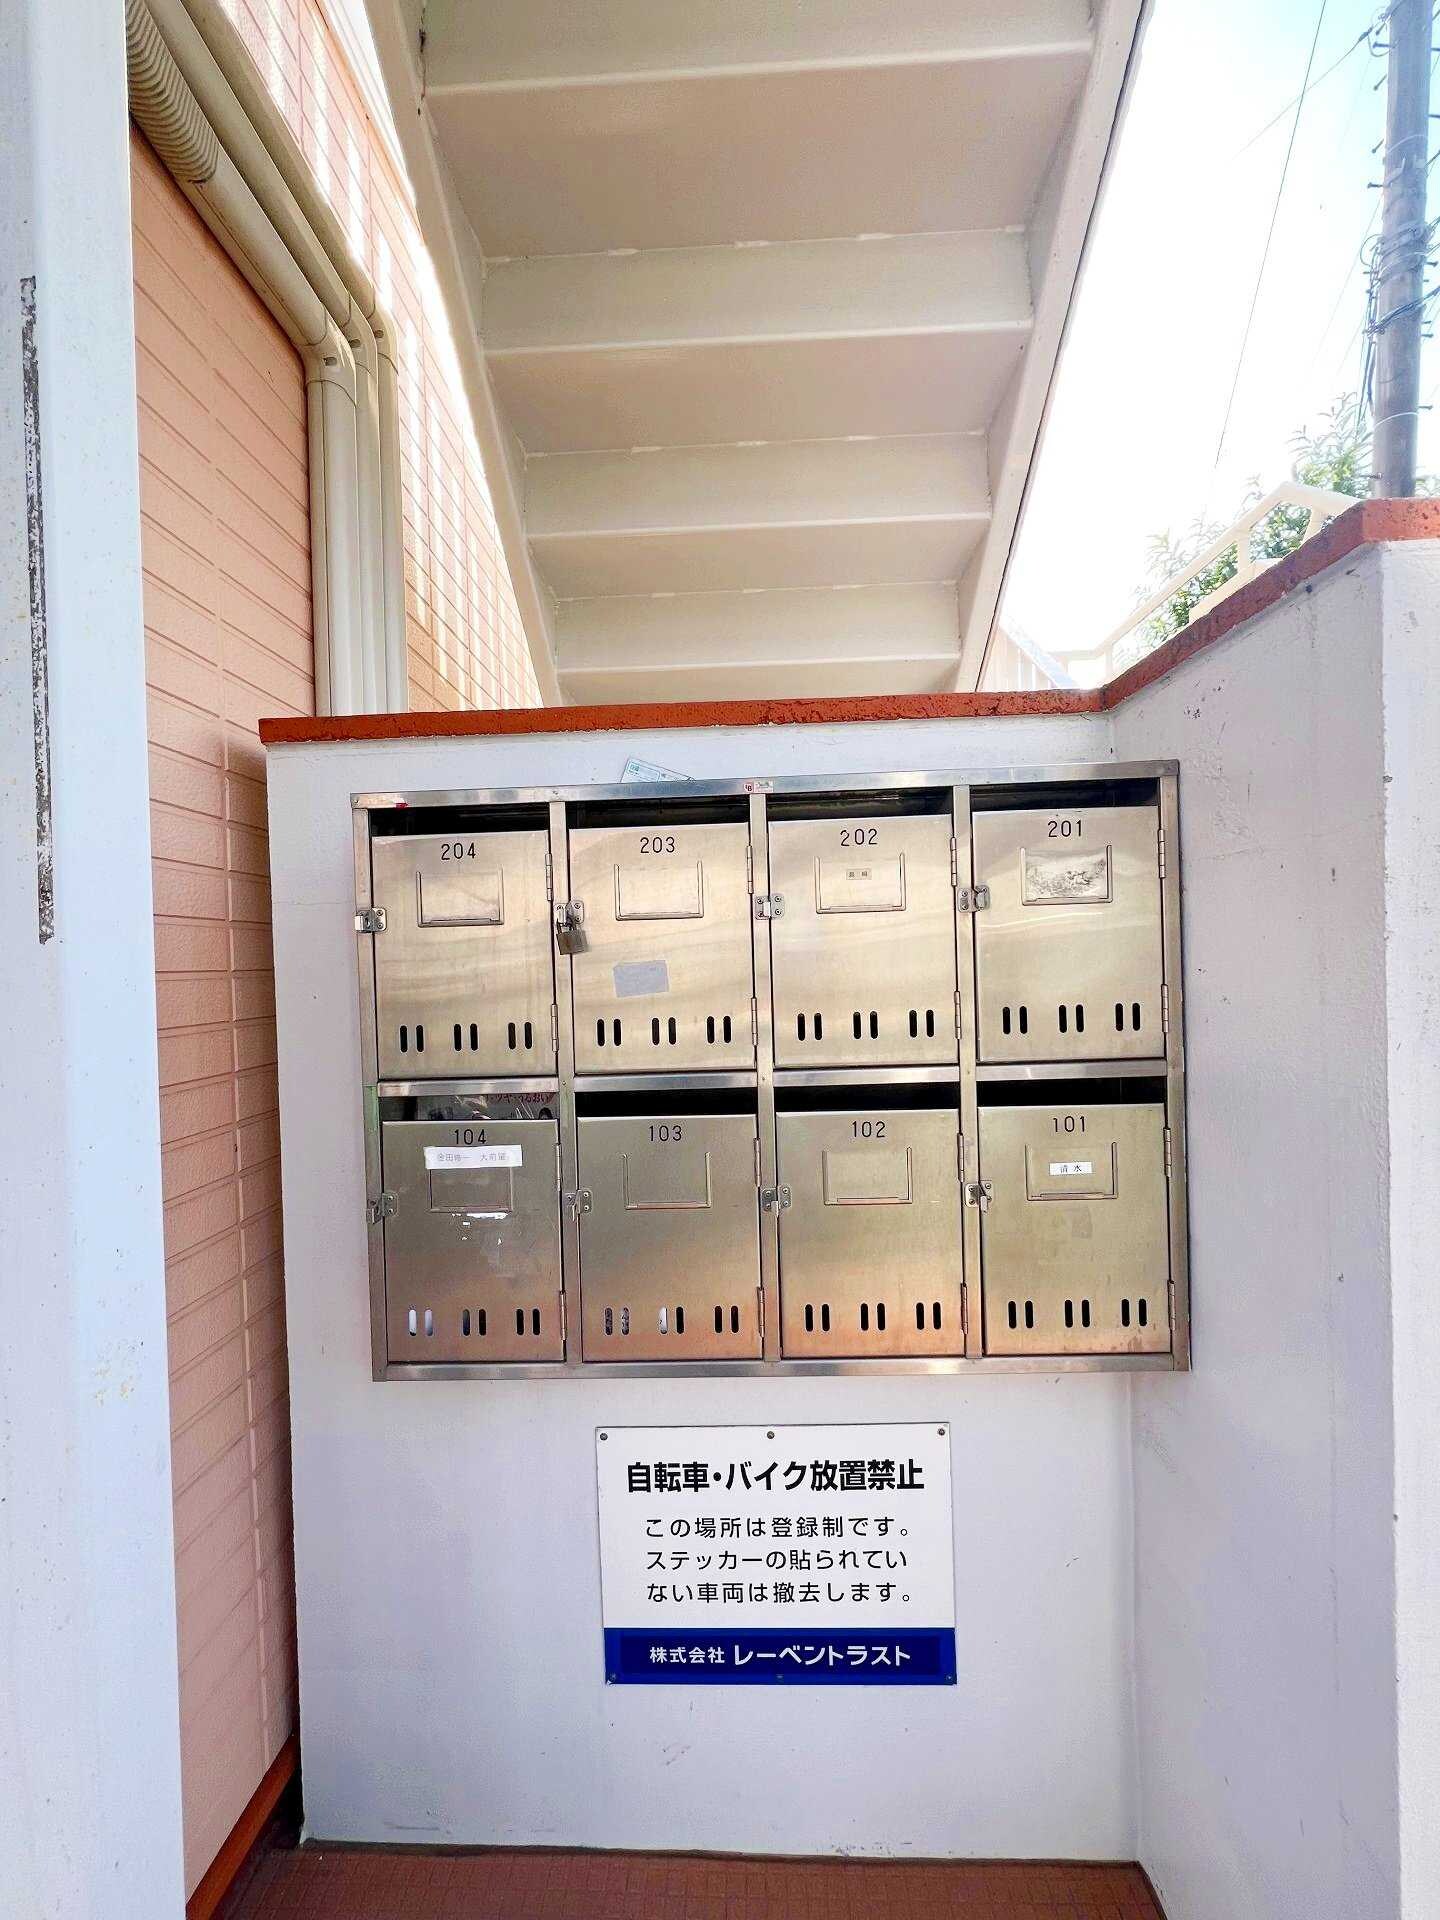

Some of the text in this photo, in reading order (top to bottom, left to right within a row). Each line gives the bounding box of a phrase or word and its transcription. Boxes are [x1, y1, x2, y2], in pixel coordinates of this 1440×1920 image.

[1047, 820, 1082, 837] 201
[640, 837, 675, 854] 203
[840, 829, 878, 846] 202
[441, 843, 476, 860] 204
[853, 1121, 885, 1138] 102
[1053, 1116, 1085, 1133] 101
[456, 1129, 487, 1146] 104
[650, 1125, 682, 1142] 103
[628, 1459, 925, 1492] 自転車・バイク放置禁止
[645, 1516, 910, 1538] この場所は登録制です。
[647, 1550, 907, 1570] ステッカーの貼られてい
[648, 1582, 910, 1603] ない車両は撤去します。
[650, 1645, 911, 1667] 株式会社 レーベントラスト
